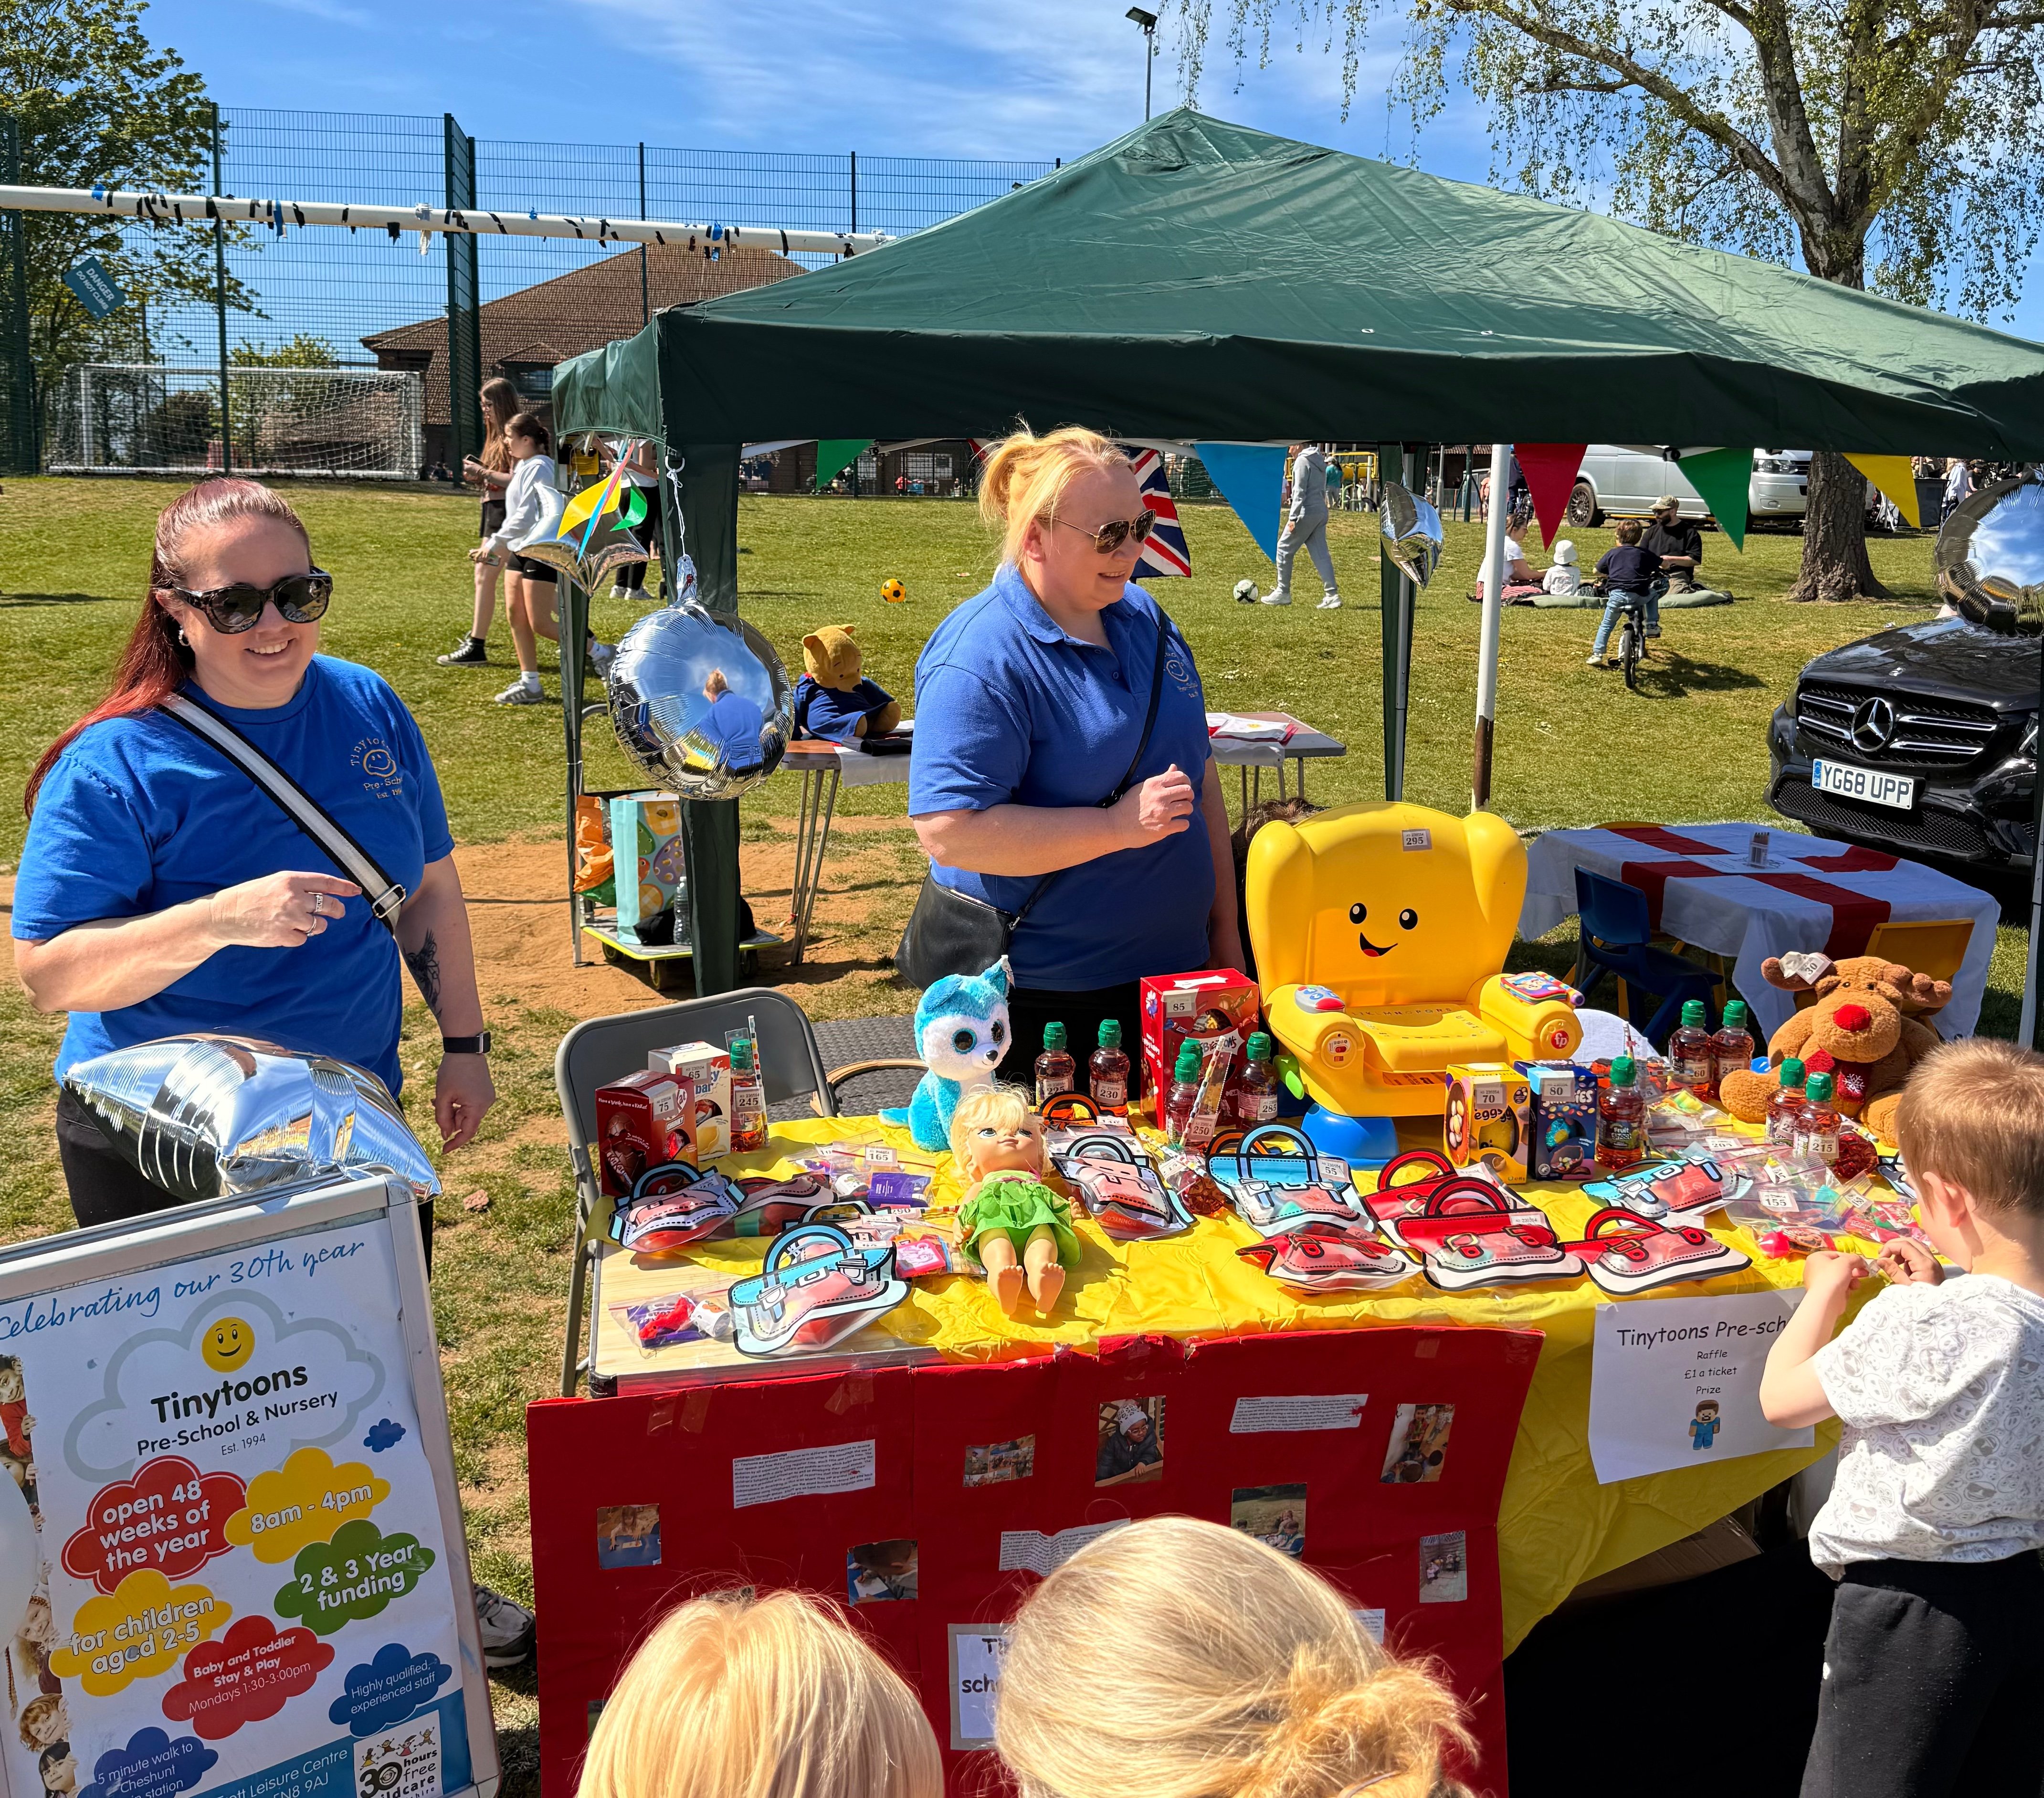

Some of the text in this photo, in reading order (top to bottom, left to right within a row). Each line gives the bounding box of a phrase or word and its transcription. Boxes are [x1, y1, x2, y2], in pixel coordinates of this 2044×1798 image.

[76, 271, 109, 310] DO NOT CLIMB
[86, 268, 115, 302] DANGER
[1823, 764, 1909, 803] YG68 UPP
[1406, 837, 1423, 845] 295
[1805, 963, 1817, 974] 30
[1173, 1003, 1185, 1011] 85
[1554, 1033, 1568, 1047] fp
[689, 1070, 700, 1079] 65
[1100, 1089, 1118, 1099] 230
[1483, 1095, 1495, 1103] 70
[1550, 1087, 1563, 1095] 80
[659, 1102, 669, 1112] 75
[739, 1098, 759, 1106] 245
[1262, 1104, 1276, 1112] 285
[1192, 1126, 1210, 1135] 250
[1812, 1142, 1832, 1152] 215
[1325, 1166, 1337, 1175] 55
[1765, 1198, 1786, 1206] 155
[174, 1273, 221, 1298] our
[230, 1249, 294, 1283] 30th
[303, 1242, 364, 1277] year
[1616, 1315, 1788, 1350] Tinytoons Pre-sch
[1696, 1349, 1728, 1360] Raffle
[1684, 1366, 1738, 1380] £1 a ticket
[150, 1366, 308, 1423] Tinytoons
[1696, 1385, 1721, 1395] Prize
[137, 1391, 337, 1455] Pre-School & Nursery
[221, 1433, 266, 1455] Est. 1994
[103, 1480, 202, 1525] open 48
[251, 1504, 302, 1534] 8am
[321, 1484, 373, 1512] 4pm
[99, 1499, 211, 1549] weeks of
[105, 1529, 210, 1572] the year
[299, 1543, 416, 1594] 2 & 3 Year
[317, 1570, 406, 1611] funding
[69, 1597, 214, 1656] for children
[92, 1620, 200, 1674] aged 2-5
[193, 1635, 296, 1678] Baby and Toddler
[214, 1657, 281, 1687] Stay & Play
[189, 1662, 311, 1714] Mondays 1:30-3:00pm
[350, 1671, 435, 1714] experienced staff
[351, 1679, 383, 1699] Highly
[962, 1673, 997, 1693] sch
[97, 1743, 193, 1785] 5 minute walk to
[404, 1749, 437, 1767] hours
[120, 1764, 176, 1793] Cheshunt
[250, 1749, 348, 1798] Leisure Centre
[305, 1772, 328, 1793] 9AJ
[359, 1762, 402, 1798] 30
[403, 1763, 436, 1782] free
[145, 1779, 184, 1798] station
